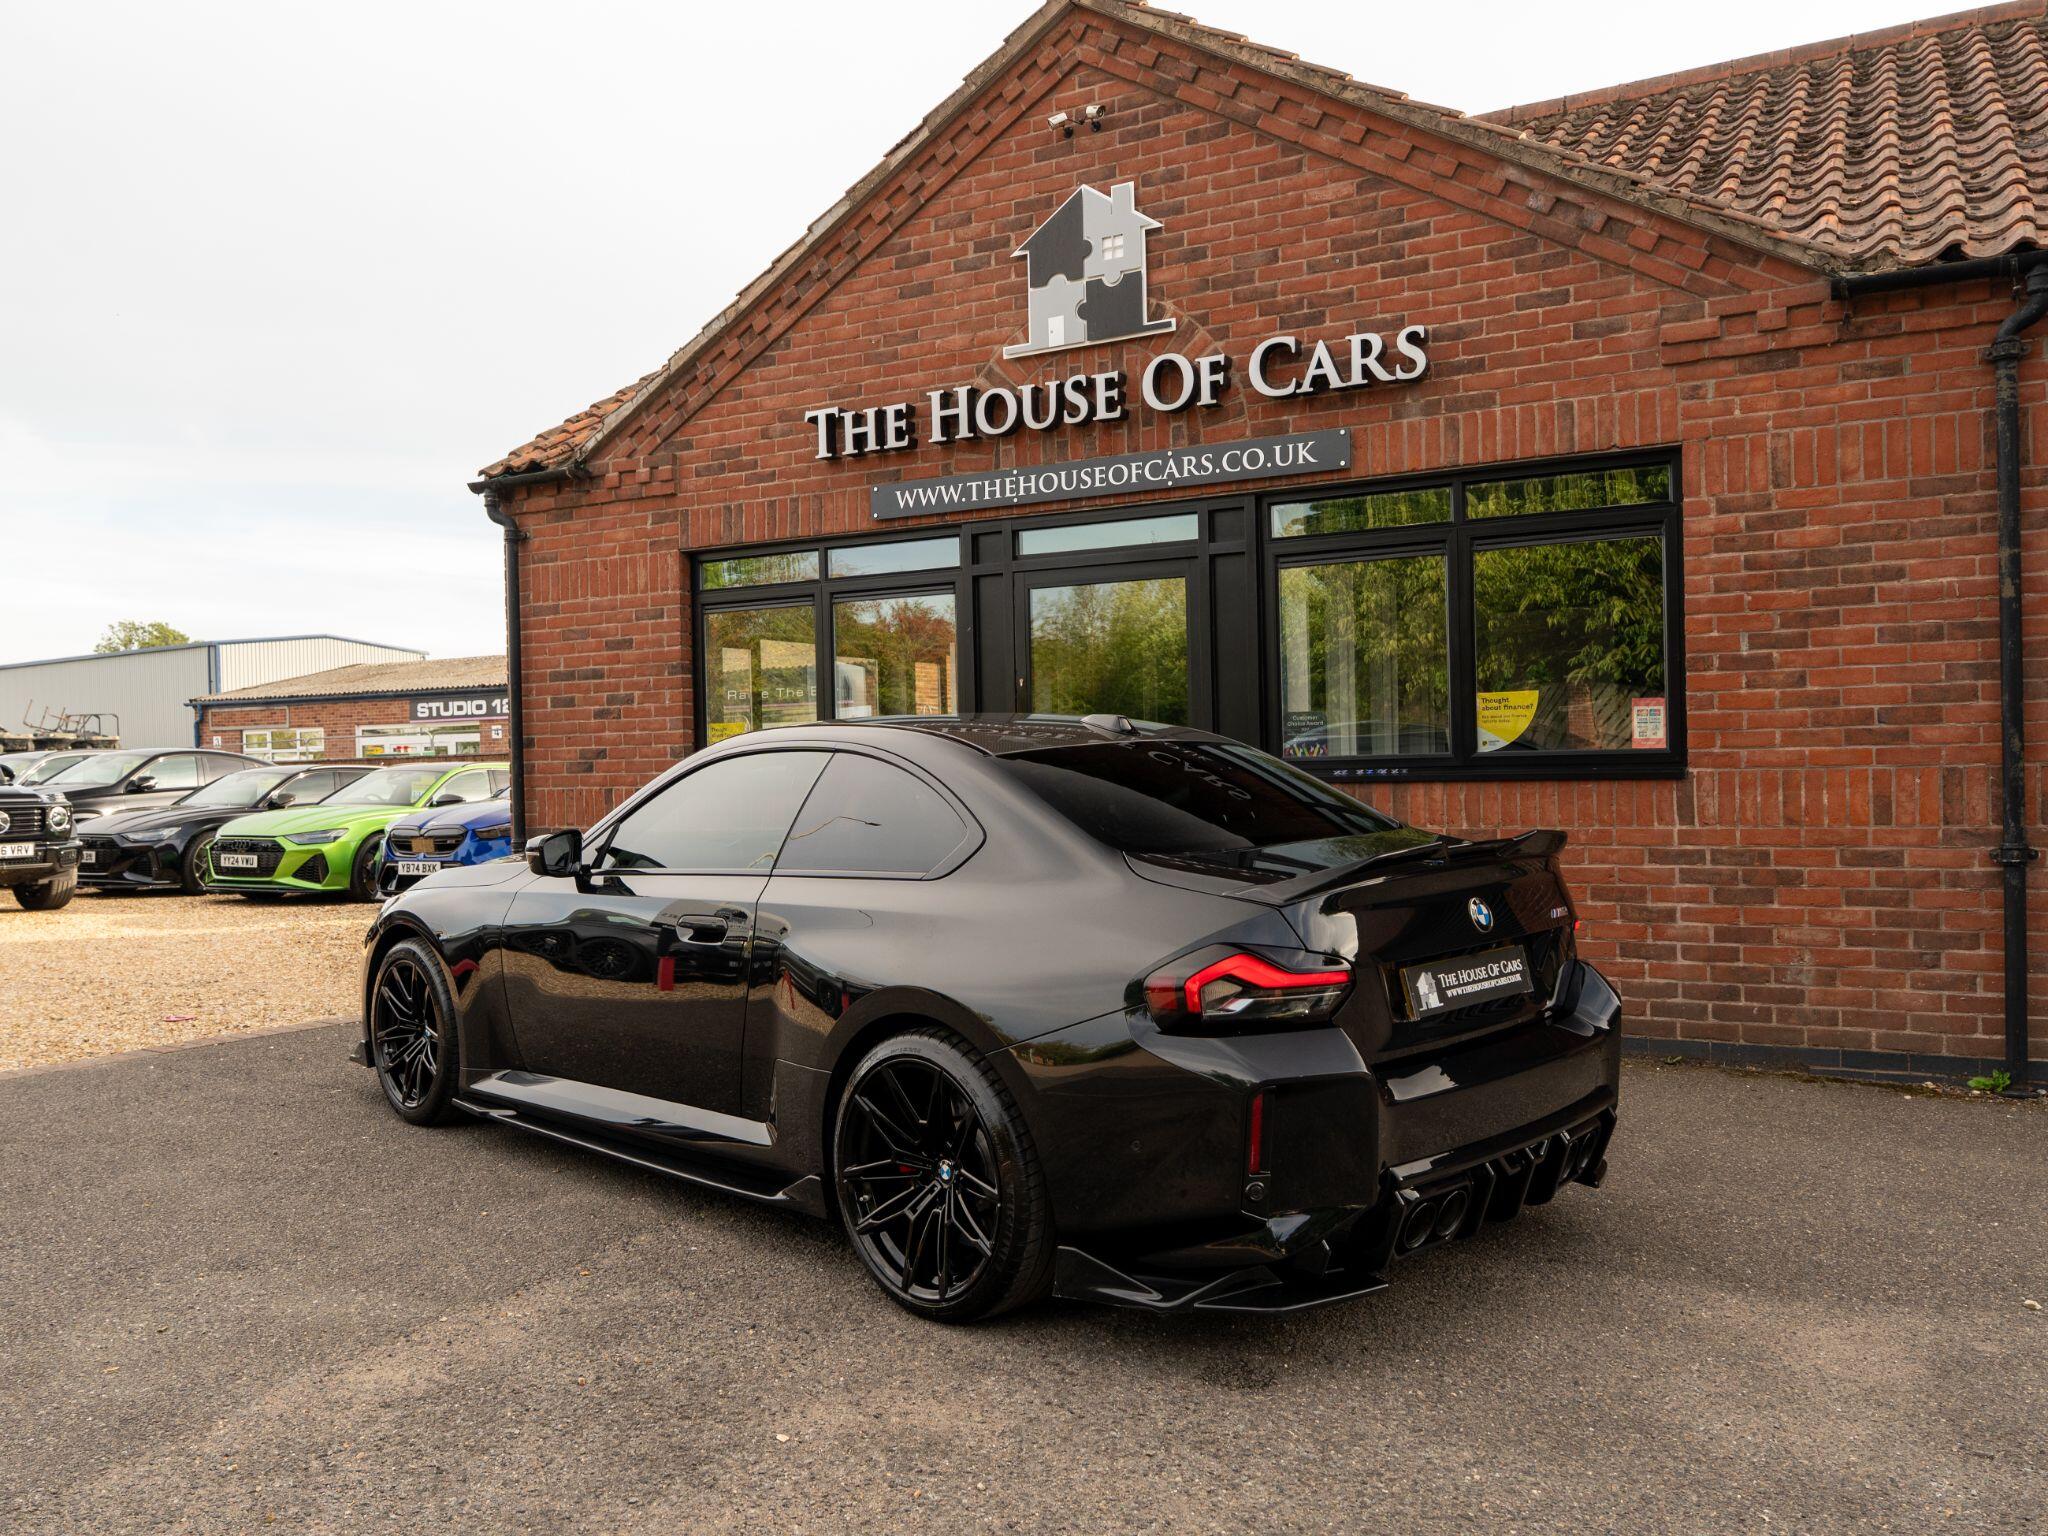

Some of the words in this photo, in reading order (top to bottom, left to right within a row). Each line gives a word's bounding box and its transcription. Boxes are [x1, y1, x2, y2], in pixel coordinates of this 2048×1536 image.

[804, 403, 910, 459] THE
[926, 370, 1123, 444] HOUSE
[1142, 352, 1226, 412] OF
[1248, 325, 1428, 397] CARS
[895, 440, 1318, 509] WWW.THEHOUSEOFCARS.CO.UK
[775, 687, 804, 699] The
[416, 699, 487, 718] STUDIO
[10, 845, 29, 855] VRV
[223, 856, 239, 865] YY24
[401, 863, 420, 872] YB74
[421, 864, 437, 872] BXK
[1437, 973, 1459, 988] THE
[1457, 966, 1488, 984] HOUSE
[1487, 963, 1500, 977] OF
[1500, 958, 1523, 974] CARS
